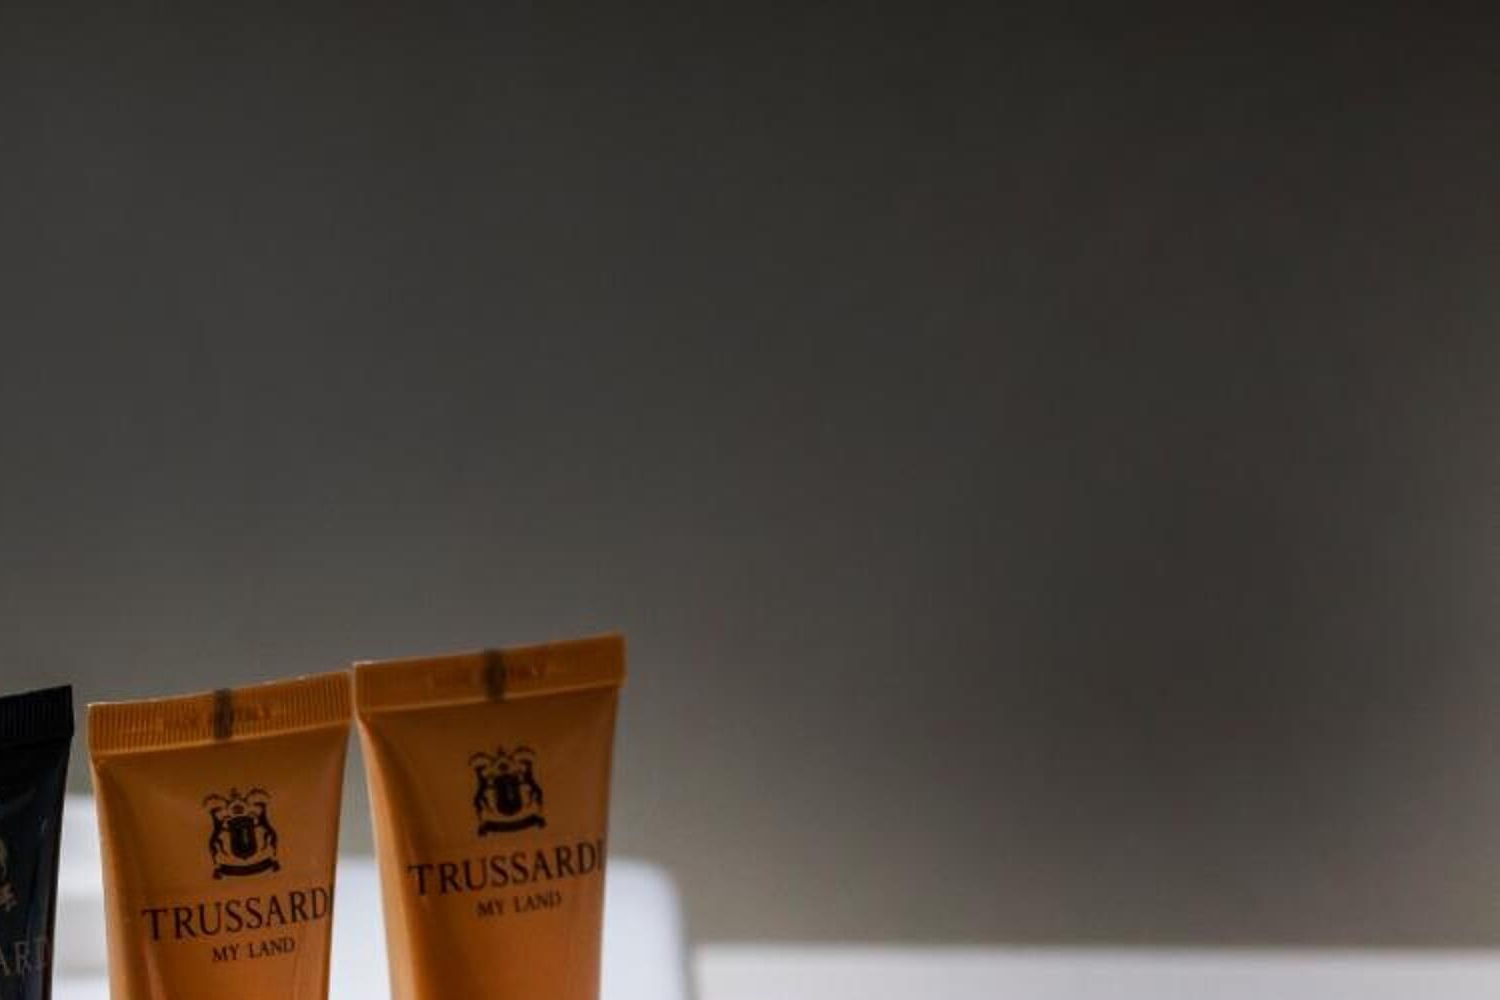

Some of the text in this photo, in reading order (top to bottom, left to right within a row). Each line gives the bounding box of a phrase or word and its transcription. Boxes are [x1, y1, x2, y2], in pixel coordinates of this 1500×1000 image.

[477, 891, 562, 917] MY LAND
[212, 937, 295, 962] MY LAND
